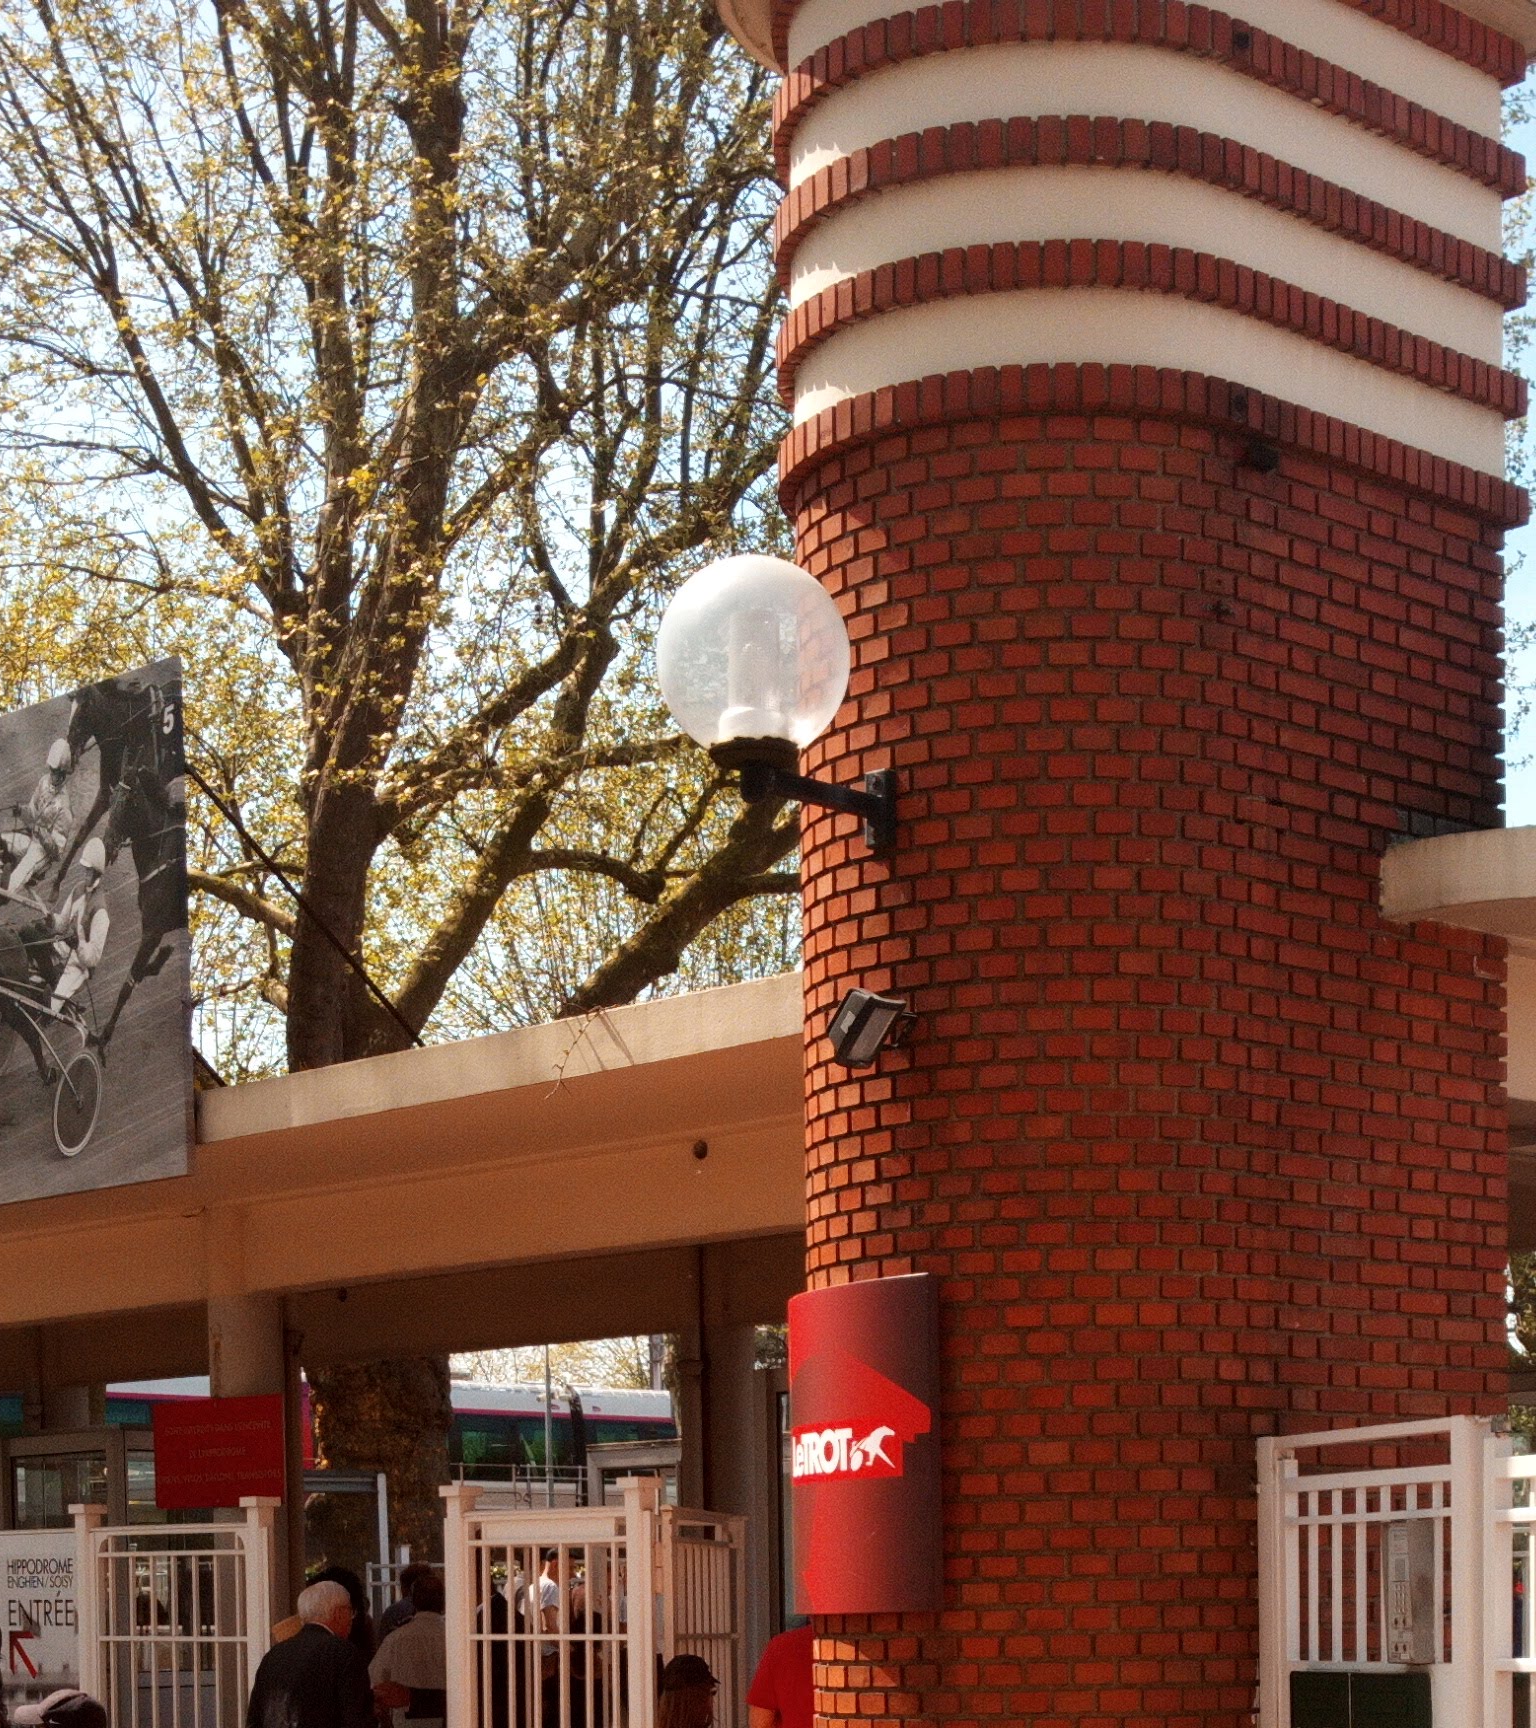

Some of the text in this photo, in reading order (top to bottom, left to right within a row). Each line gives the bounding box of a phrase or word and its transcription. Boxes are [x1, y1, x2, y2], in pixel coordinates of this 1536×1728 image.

[163, 703, 174, 734] 5
[7, 1558, 73, 1575] HIPPODROME
[8, 1590, 75, 1626] ENTRÉE
